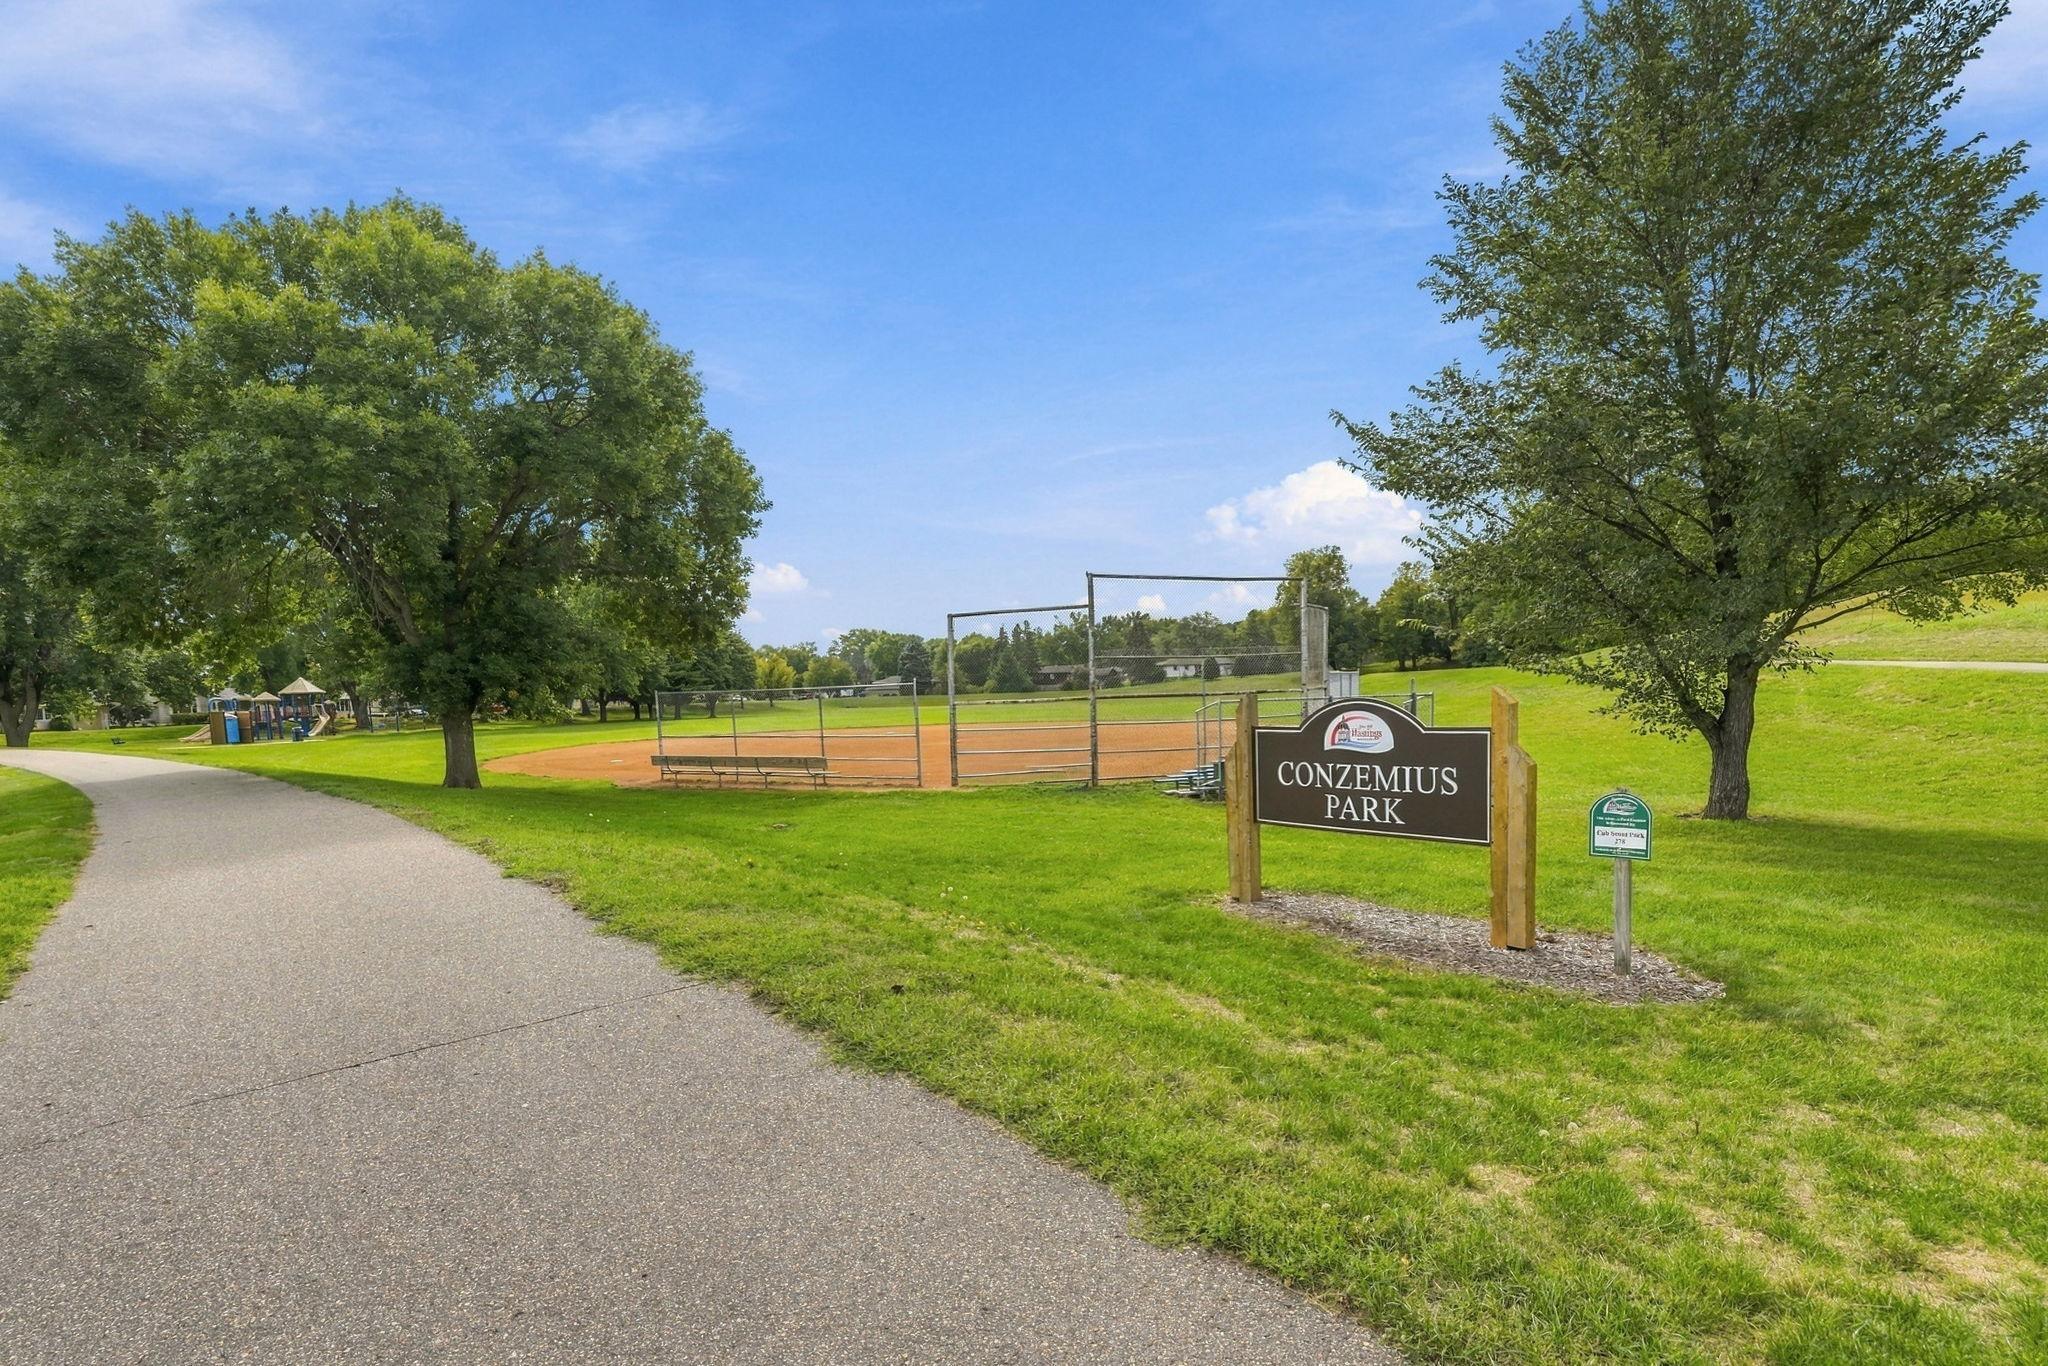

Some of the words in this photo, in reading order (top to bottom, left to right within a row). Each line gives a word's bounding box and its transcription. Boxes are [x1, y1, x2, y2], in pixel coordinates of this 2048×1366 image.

[1351, 728, 1383, 740] Hastings
[1277, 761, 1458, 796] CONZEMIUS
[1324, 793, 1406, 825] PARK
